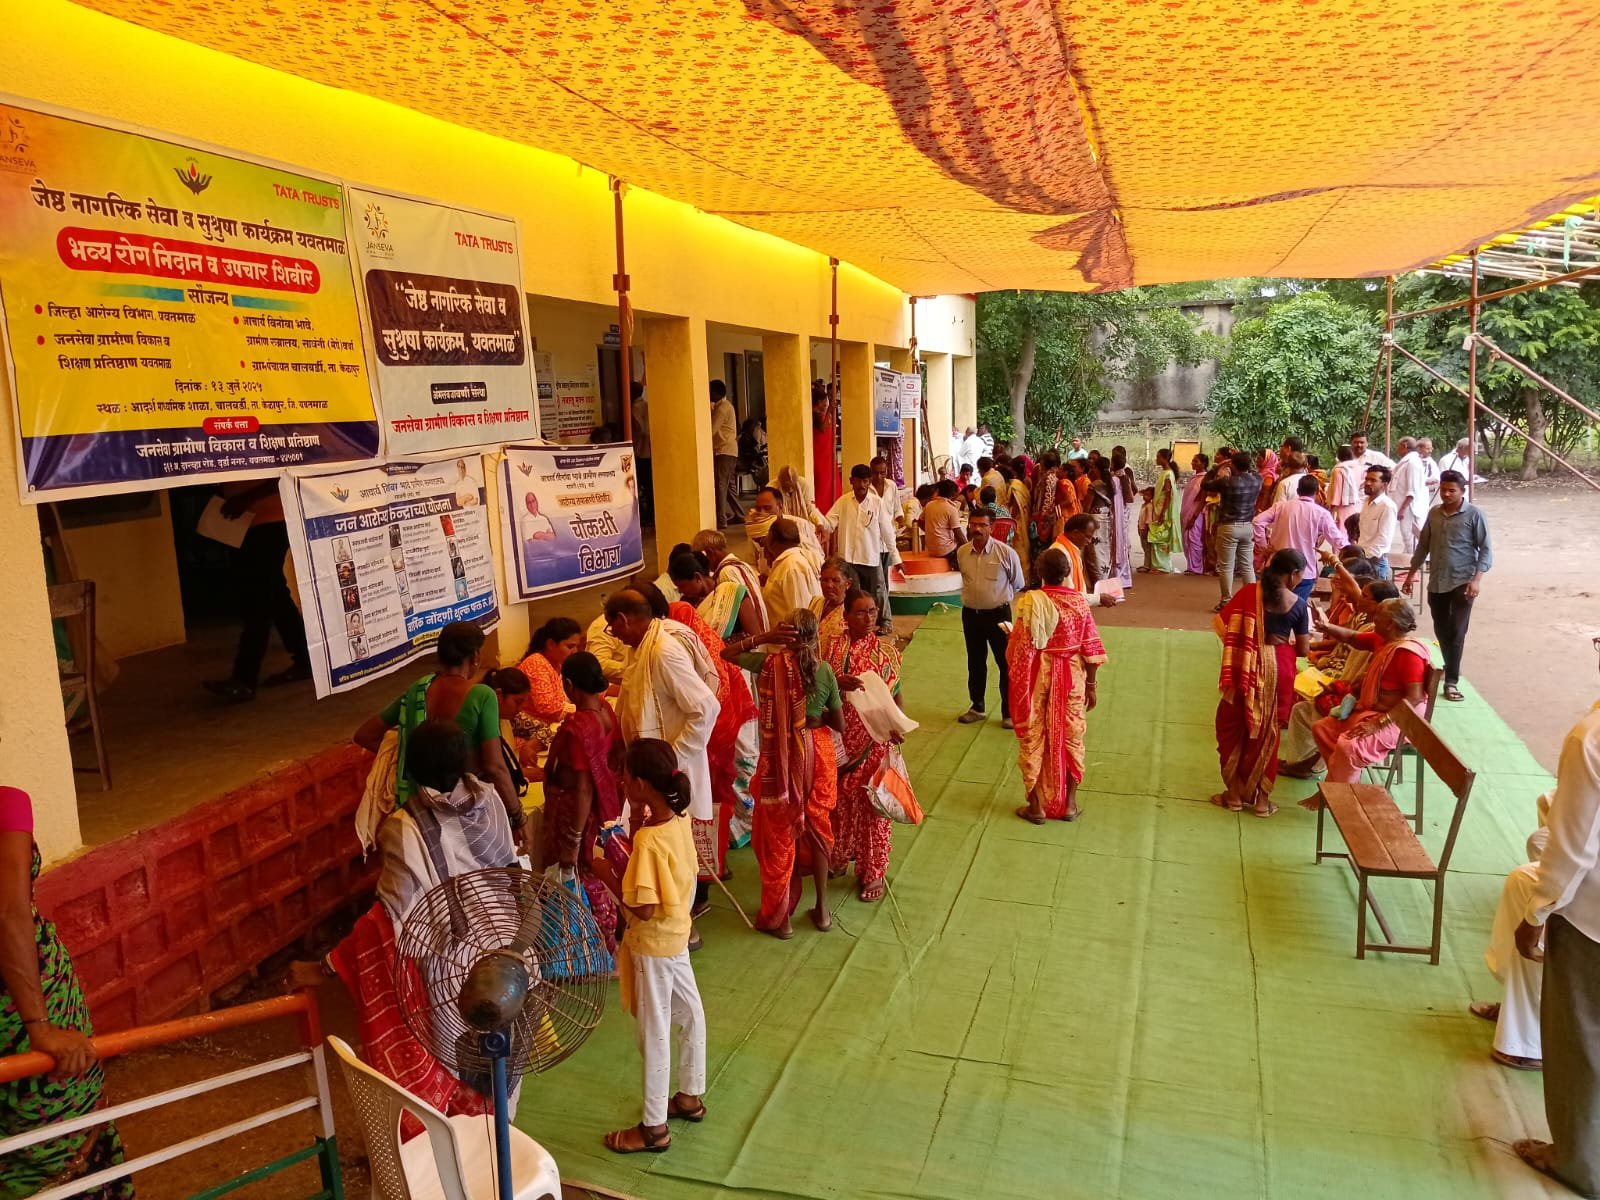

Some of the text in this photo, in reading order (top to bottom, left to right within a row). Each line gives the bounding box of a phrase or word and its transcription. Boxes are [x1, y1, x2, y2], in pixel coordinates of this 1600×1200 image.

[0, 155, 37, 169] ANSEVA
[272, 183, 341, 210] TATA TRUSTS
[30, 178, 66, 213] जेष्ठ
[69, 191, 142, 220] नागरिक
[145, 196, 179, 227] सेवा
[181, 210, 195, 230] व
[240, 218, 294, 247] कार्यक्रम
[295, 231, 346, 256] यवतमाळ
[365, 241, 394, 252] JANSEVA
[454, 231, 514, 254] TATA TRUSTS
[67, 236, 112, 264] भव्य
[114, 236, 150, 267] रोग
[152, 241, 203, 276] निदान
[205, 255, 219, 276] व
[220, 257, 270, 284] उपचार
[186, 283, 230, 307] सौजन्य
[429, 286, 473, 313] नागरिक
[473, 287, 496, 315] सेवा
[497, 297, 507, 316] व
[47, 301, 81, 321] जिल्हा
[85, 303, 121, 320] आरोग्य
[158, 310, 196, 324] यवतमाळ
[242, 313, 266, 328] आचार्य
[267, 314, 294, 330] विनोबा
[54, 329, 171, 347] जनसेवा ग्रामीण विकास व
[245, 333, 269, 347] ग्रामीण
[58, 354, 91, 370] शिक्षण
[140, 357, 172, 369] यवतमाळ
[174, 378, 202, 394] दिनांक
[210, 380, 225, 393] १३
[242, 380, 263, 394] २०२५
[96, 402, 121, 415] स्थळ
[130, 397, 156, 415] आदर्श
[298, 399, 329, 410] यवतमाळ
[213, 417, 249, 431] संपर्क पत्ता
[391, 414, 424, 434] जनसेवा
[424, 412, 449, 431] ग्रामीण
[448, 411, 476, 428] विकास
[477, 413, 483, 424] व
[483, 409, 502, 426] शिक्षण
[134, 437, 171, 458] जनसेवा
[171, 436, 206, 457] ग्रामीण
[208, 435, 246, 453] विकास
[248, 437, 257, 450] व
[259, 433, 286, 451] शिक्षण
[248, 455, 276, 465] यवतमाळ
[359, 482, 382, 499] आचार्य
[334, 515, 358, 533] जन
[359, 507, 389, 529] आरोग्य
[427, 497, 453, 514] योजना
[569, 510, 619, 538] चौकशी
[578, 544, 621, 573] विभाग
[425, 607, 454, 627] नोंदणी
[453, 604, 471, 622] शुल्क
